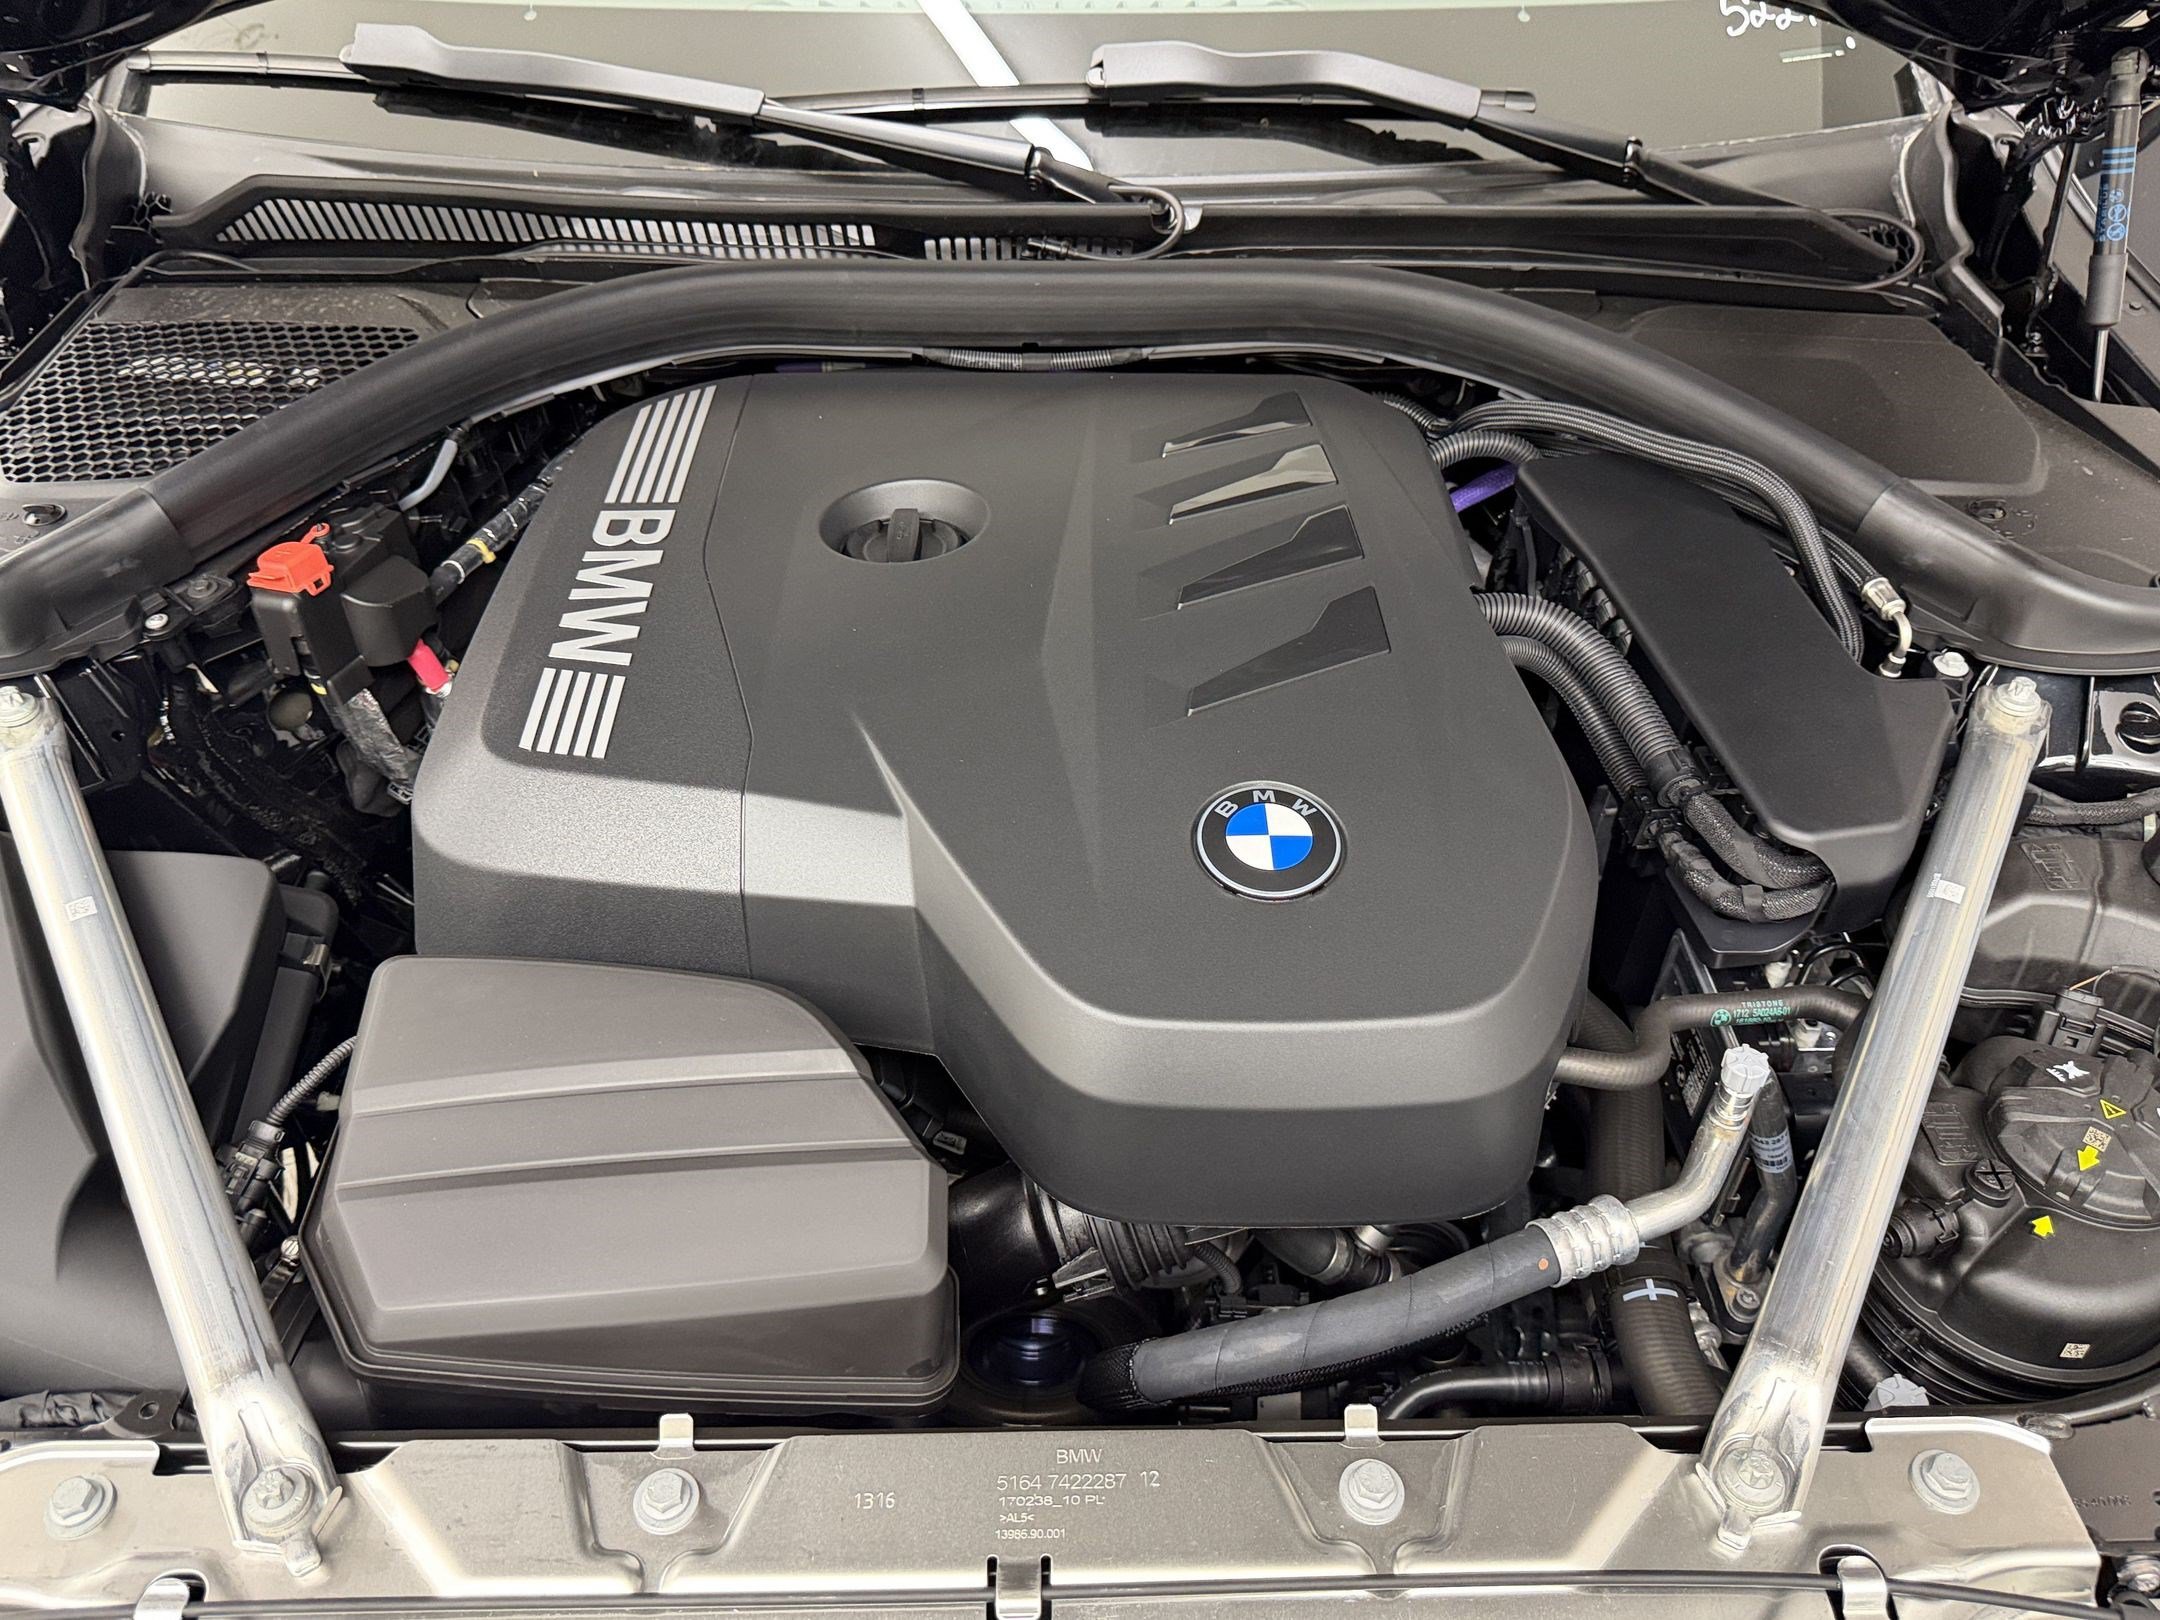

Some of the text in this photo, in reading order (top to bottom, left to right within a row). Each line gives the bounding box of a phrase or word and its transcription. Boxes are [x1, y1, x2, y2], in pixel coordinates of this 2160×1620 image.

[548, 509, 677, 667] BMW
[1214, 789, 1318, 819] BMW
[1741, 999, 1784, 1009] TRISTONE
[1733, 1008, 1750, 1018] 1712
[1056, 1449, 1102, 1464] BMW
[996, 1470, 1161, 1491] 5164 7422287 12
[854, 1491, 896, 1510] 1316
[998, 1494, 1081, 1508] 170238_10
